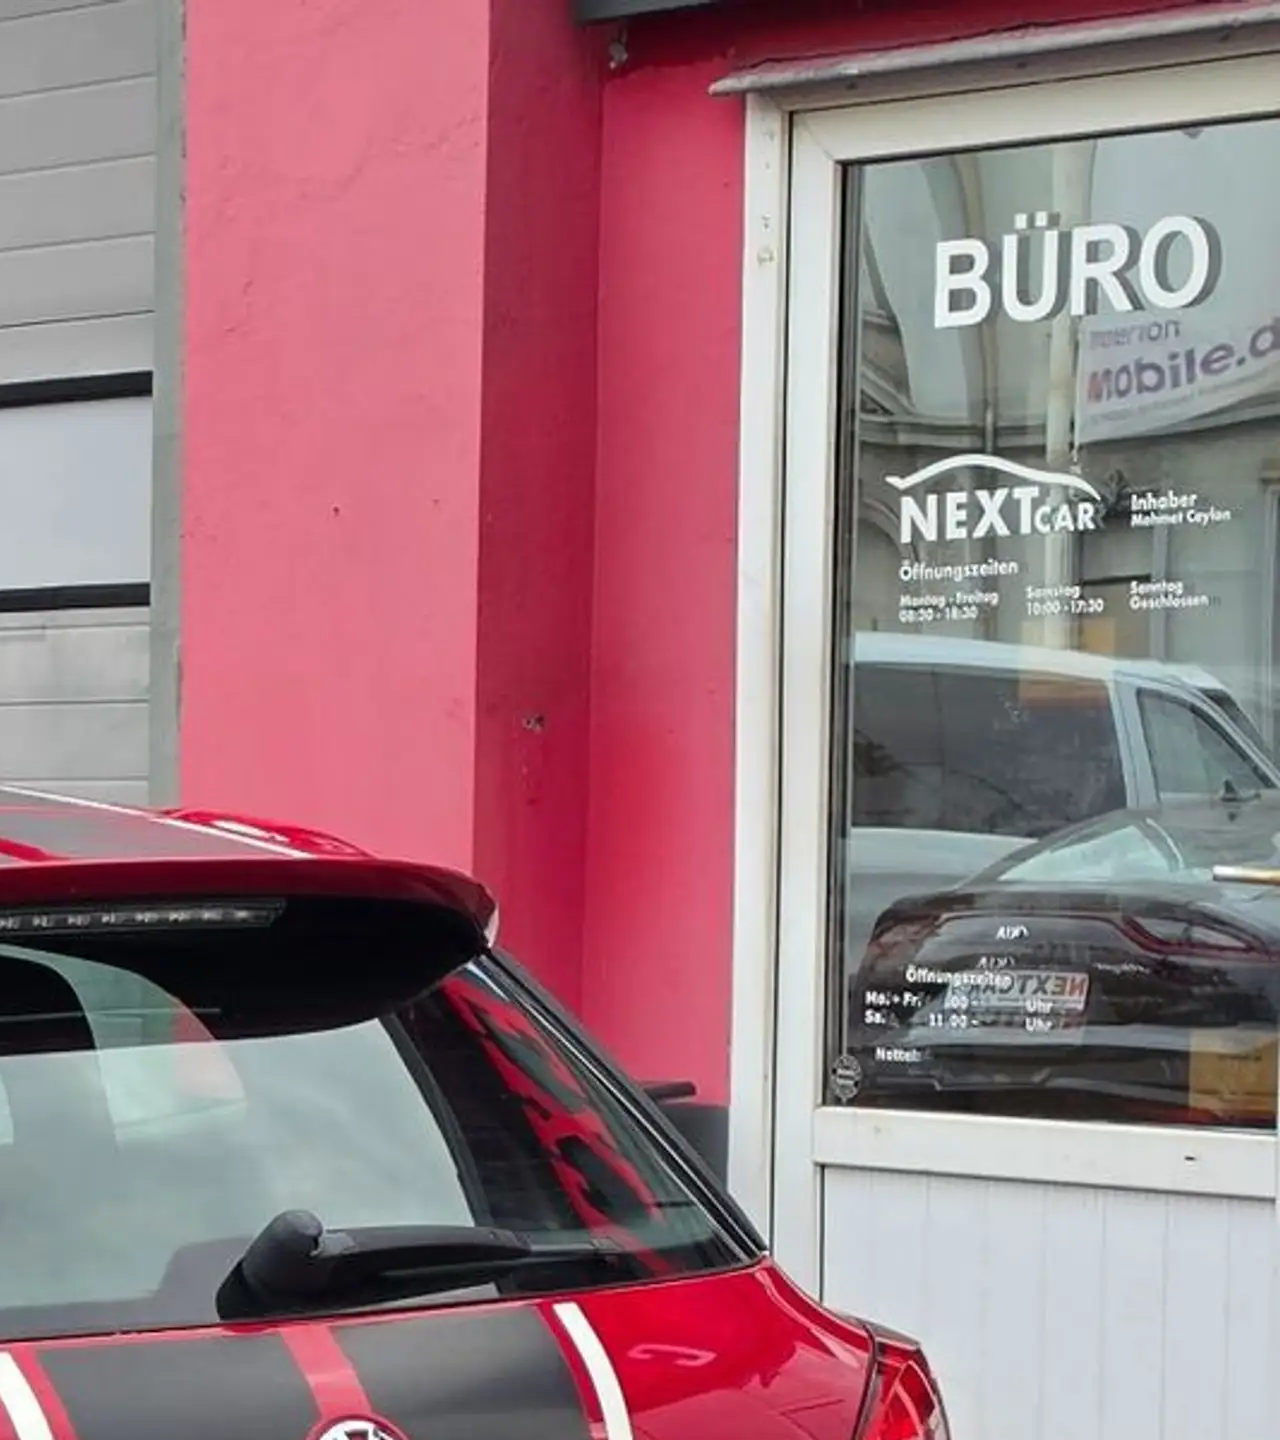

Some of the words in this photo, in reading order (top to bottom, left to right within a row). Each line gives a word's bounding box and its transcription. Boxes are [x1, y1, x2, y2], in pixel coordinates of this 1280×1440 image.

[934, 210, 1210, 329] BÜRO
[1130, 490, 1197, 511] Inhaber
[899, 558, 1019, 582] Öffnungszeiten
[1025, 999, 1053, 1014] Uhr
[1025, 1016, 1053, 1033] Uhr
